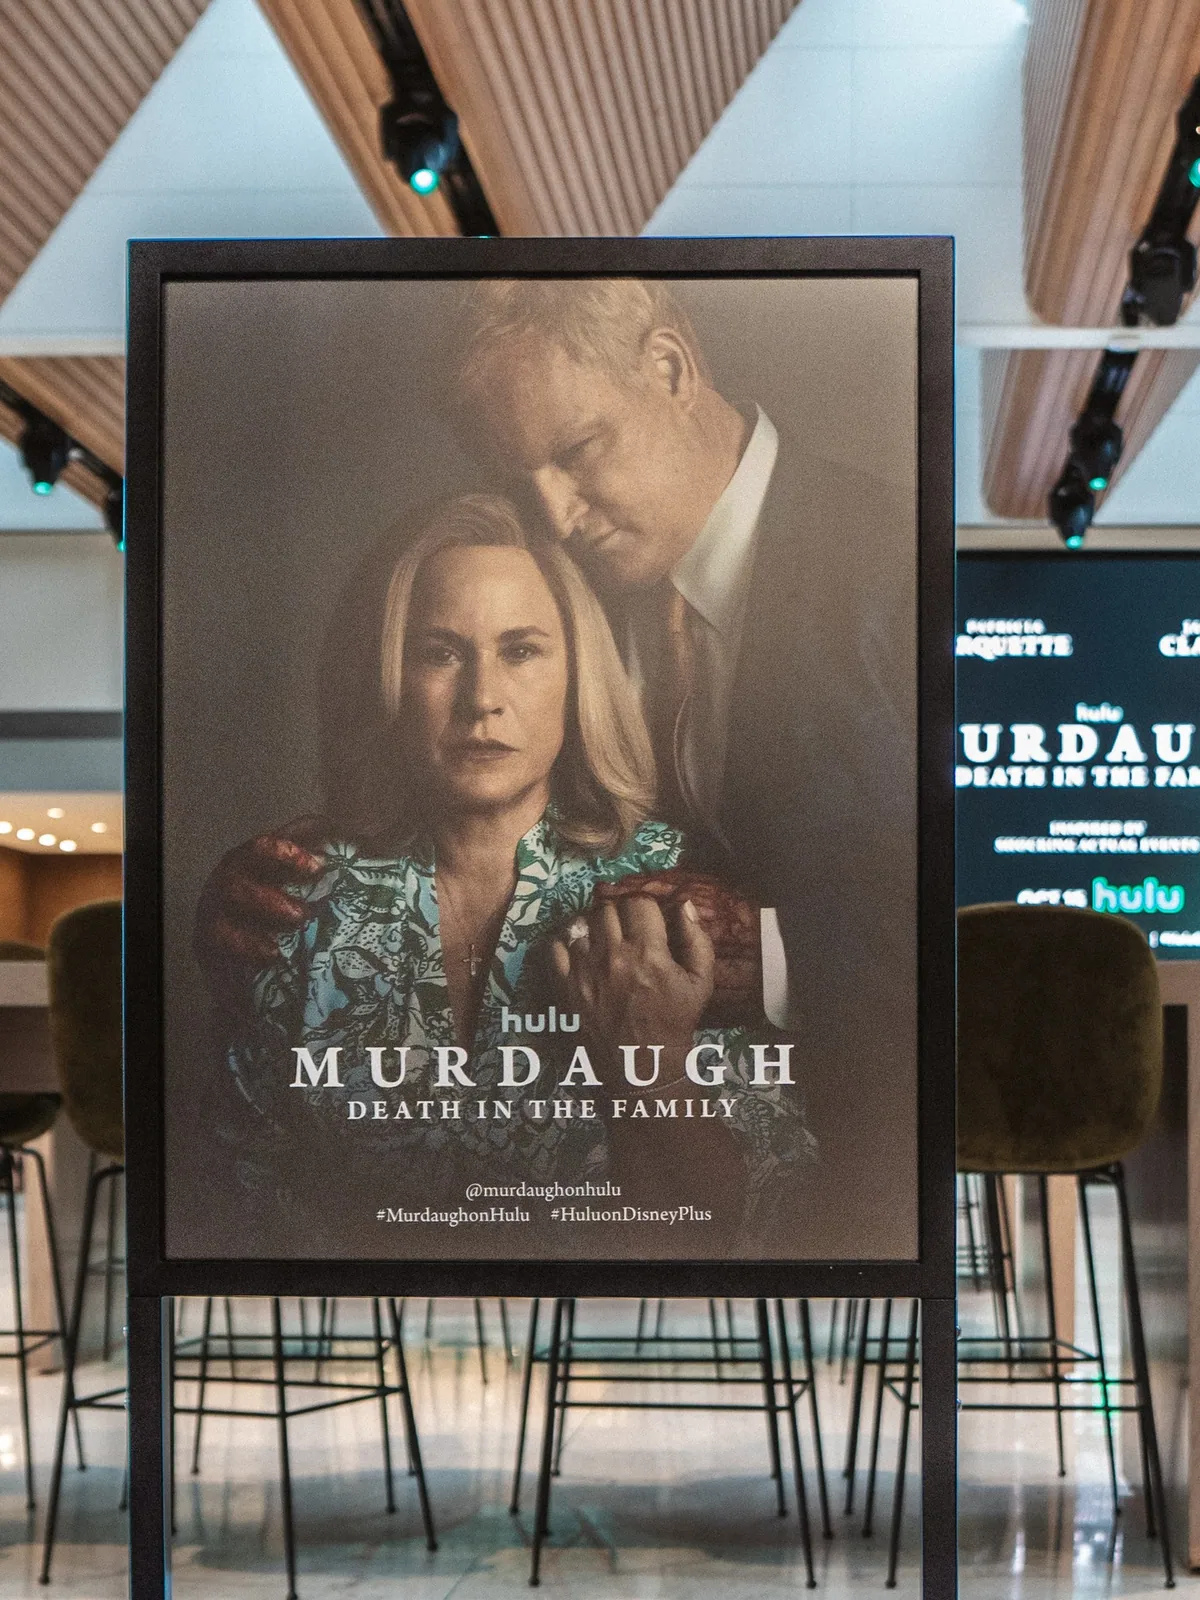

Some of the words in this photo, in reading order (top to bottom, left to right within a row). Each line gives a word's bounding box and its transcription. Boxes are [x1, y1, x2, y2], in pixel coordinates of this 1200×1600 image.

[955, 634, 1073, 661] RQUETTE
[955, 765, 1047, 788] DEATH
[1052, 765, 1087, 788] IN
[1091, 765, 1149, 788] THE
[1092, 876, 1184, 914] hulu
[501, 1005, 580, 1033] hulu
[289, 1043, 797, 1088] MURDAUGH
[347, 1100, 461, 1120] DEATH
[476, 1100, 514, 1119] IN
[528, 1099, 597, 1119] THE
[611, 1098, 738, 1118] FAMILY
[465, 1181, 622, 1202] @murdaughonhulu
[376, 1207, 530, 1227] #MurdaughonHulu
[550, 1206, 712, 1225] #HuluonDisneyPlus
